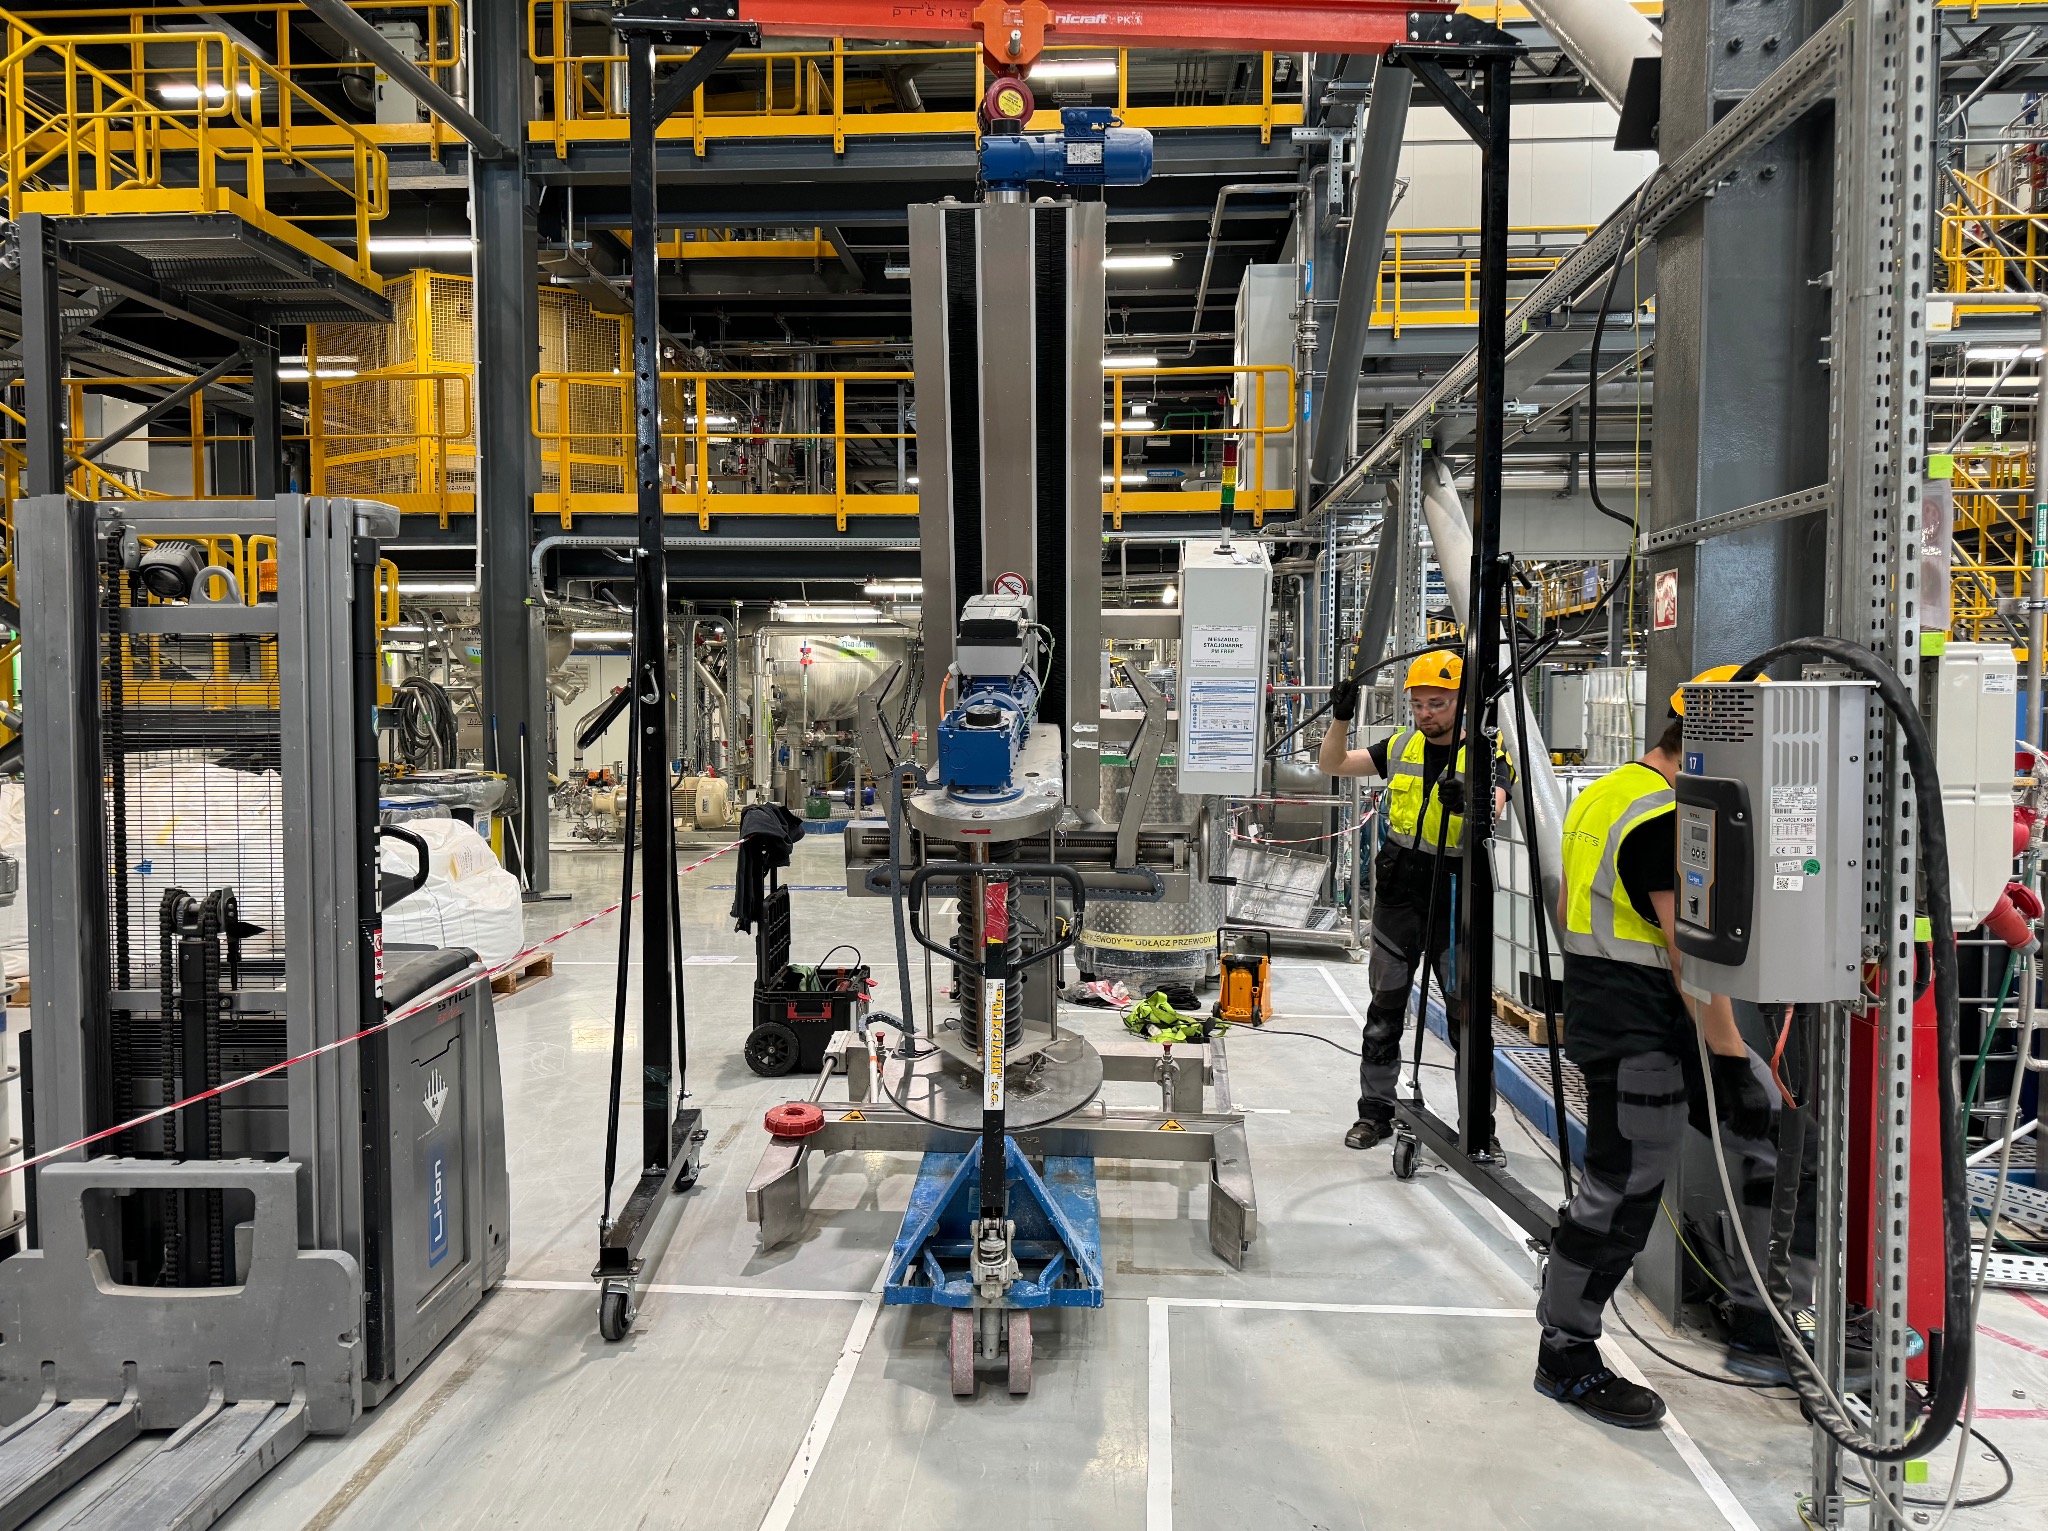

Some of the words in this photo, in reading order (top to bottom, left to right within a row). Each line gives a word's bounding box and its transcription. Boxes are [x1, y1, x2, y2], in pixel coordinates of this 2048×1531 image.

[892, 9, 968, 18] proMe
[1056, 14, 1107, 24] nicraft
[1689, 757, 1697, 769] 17
[438, 989, 472, 1012] STILL
